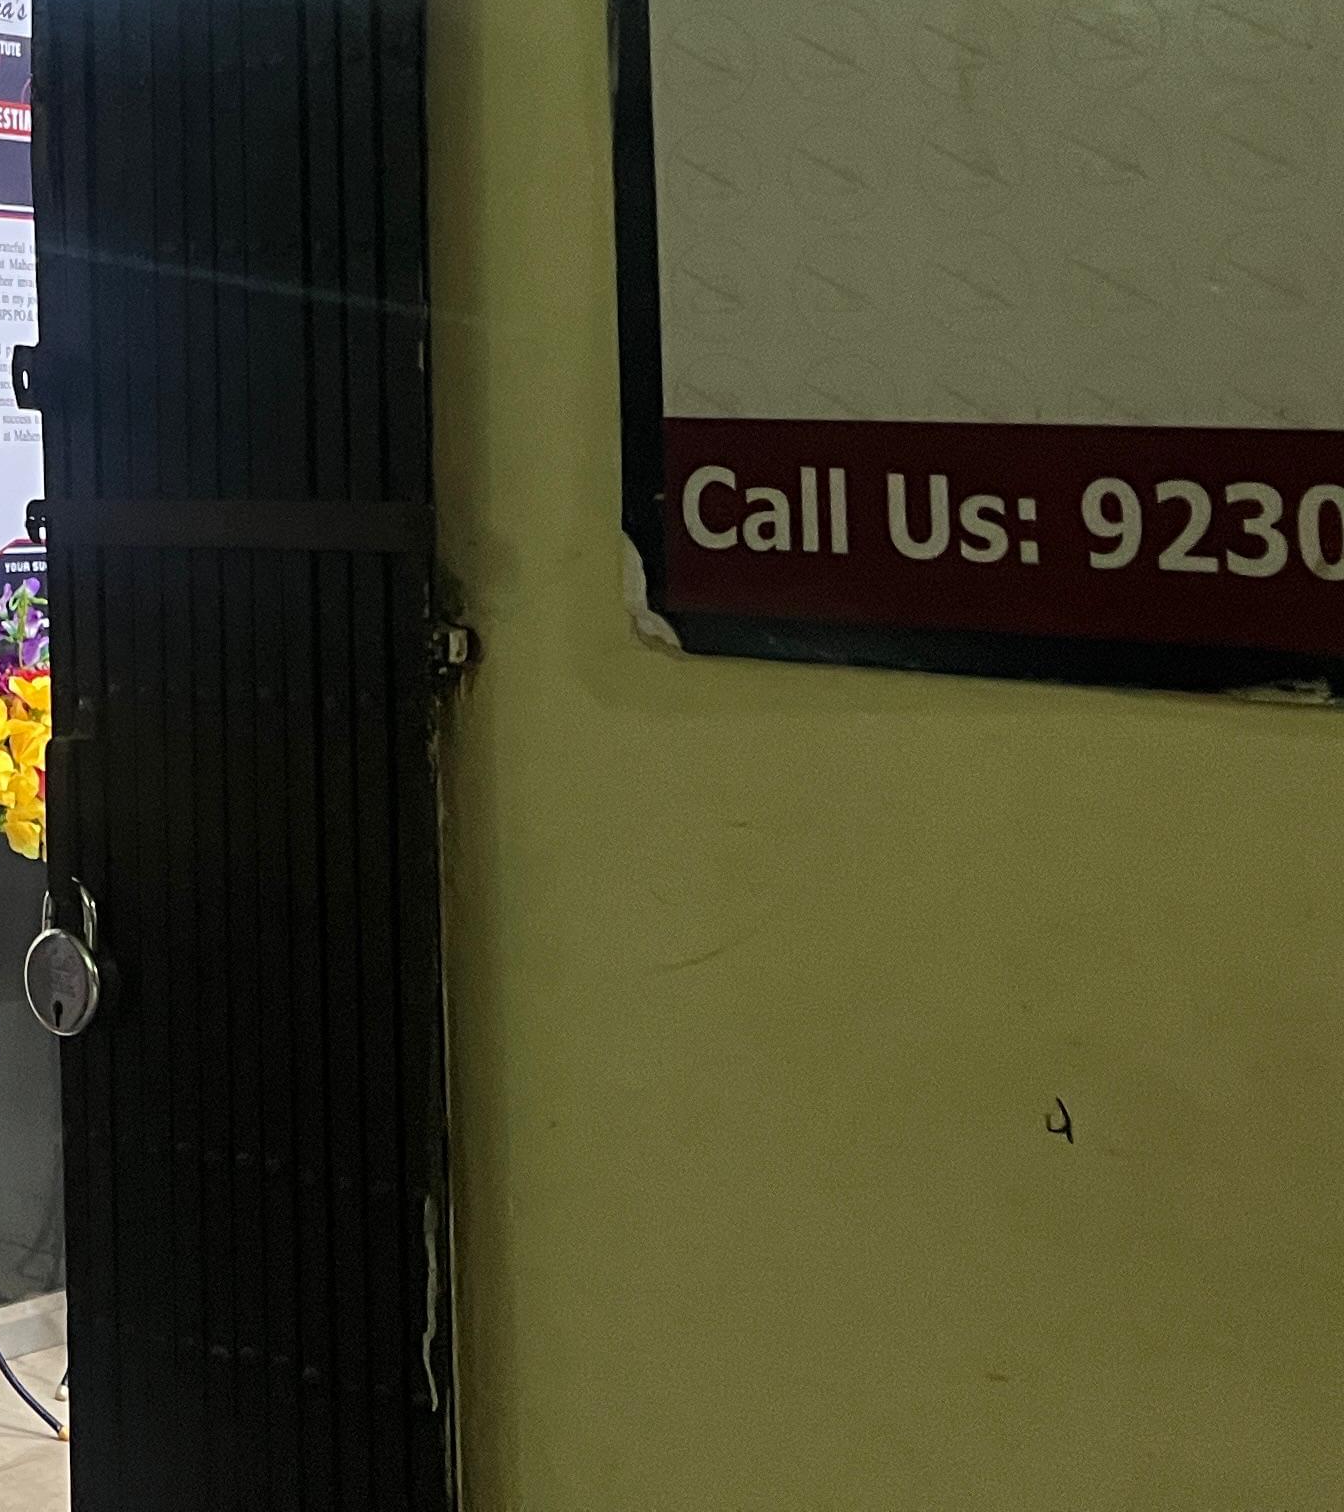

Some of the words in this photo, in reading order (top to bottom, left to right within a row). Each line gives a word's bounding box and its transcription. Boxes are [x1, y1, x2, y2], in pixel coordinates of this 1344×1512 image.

[681, 465, 850, 555] Call
[886, 473, 1040, 565] Us:
[32, 561, 47, 571] SU
